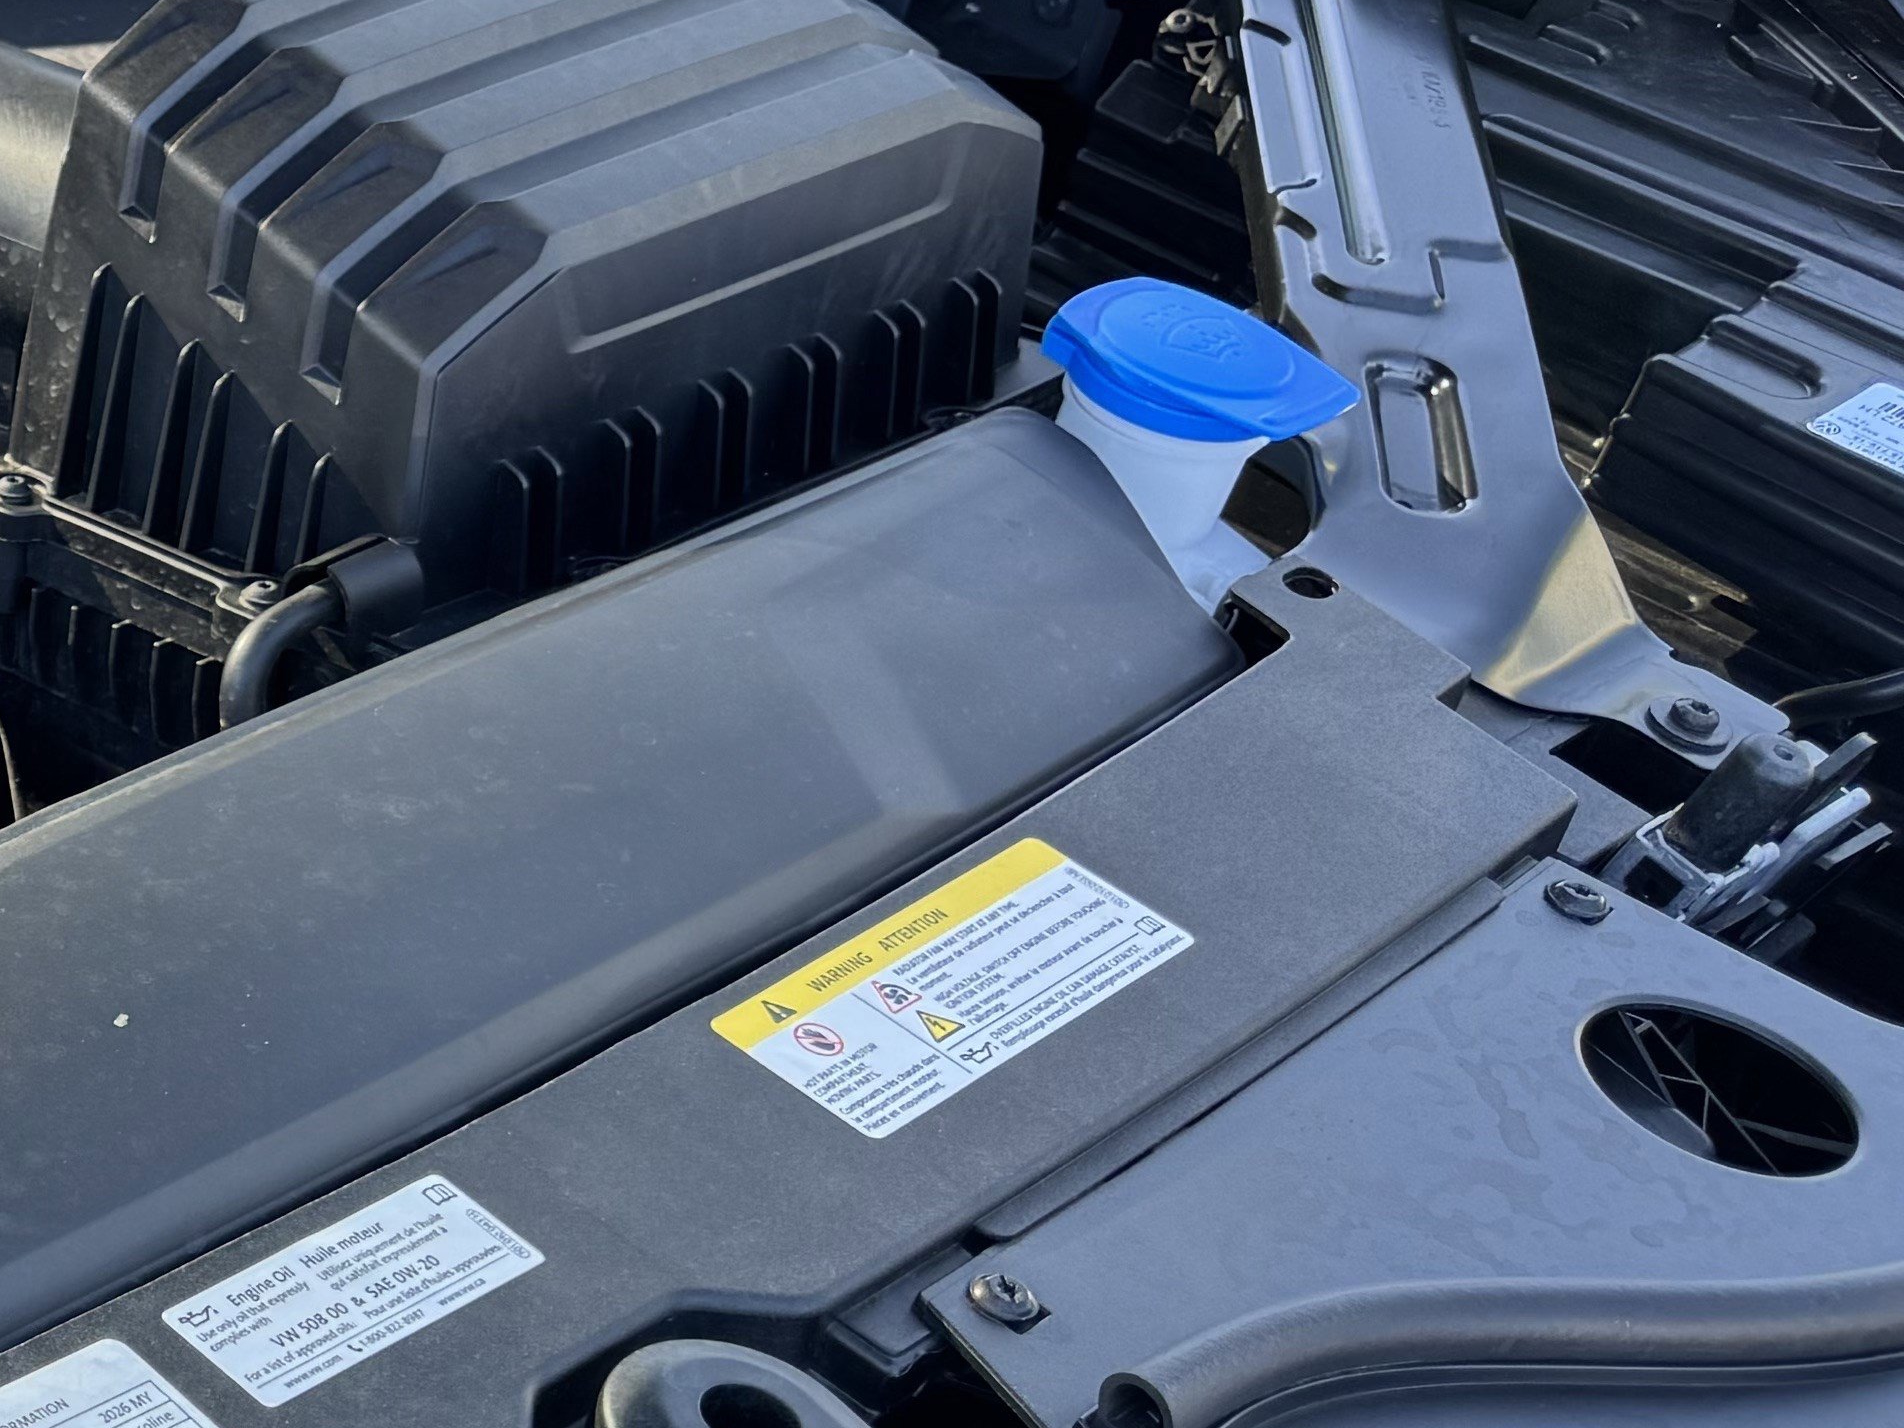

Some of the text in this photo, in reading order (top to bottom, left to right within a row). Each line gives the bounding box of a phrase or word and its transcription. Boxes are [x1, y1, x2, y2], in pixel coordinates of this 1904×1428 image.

[805, 908, 949, 992] WARNING ATTENTION
[298, 1221, 385, 1269] Huile moteur
[225, 1265, 297, 1307] Engine Oil
[269, 1326, 301, 1348] VW
[296, 1312, 329, 1335] 508
[325, 1302, 350, 1319] 00
[364, 1276, 397, 1299] SAE
[391, 1254, 441, 1284] 0W-20
[209, 1316, 273, 1353] complies with
[294, 1329, 339, 1358] approved
[97, 1391, 153, 1424] 2026 MY
